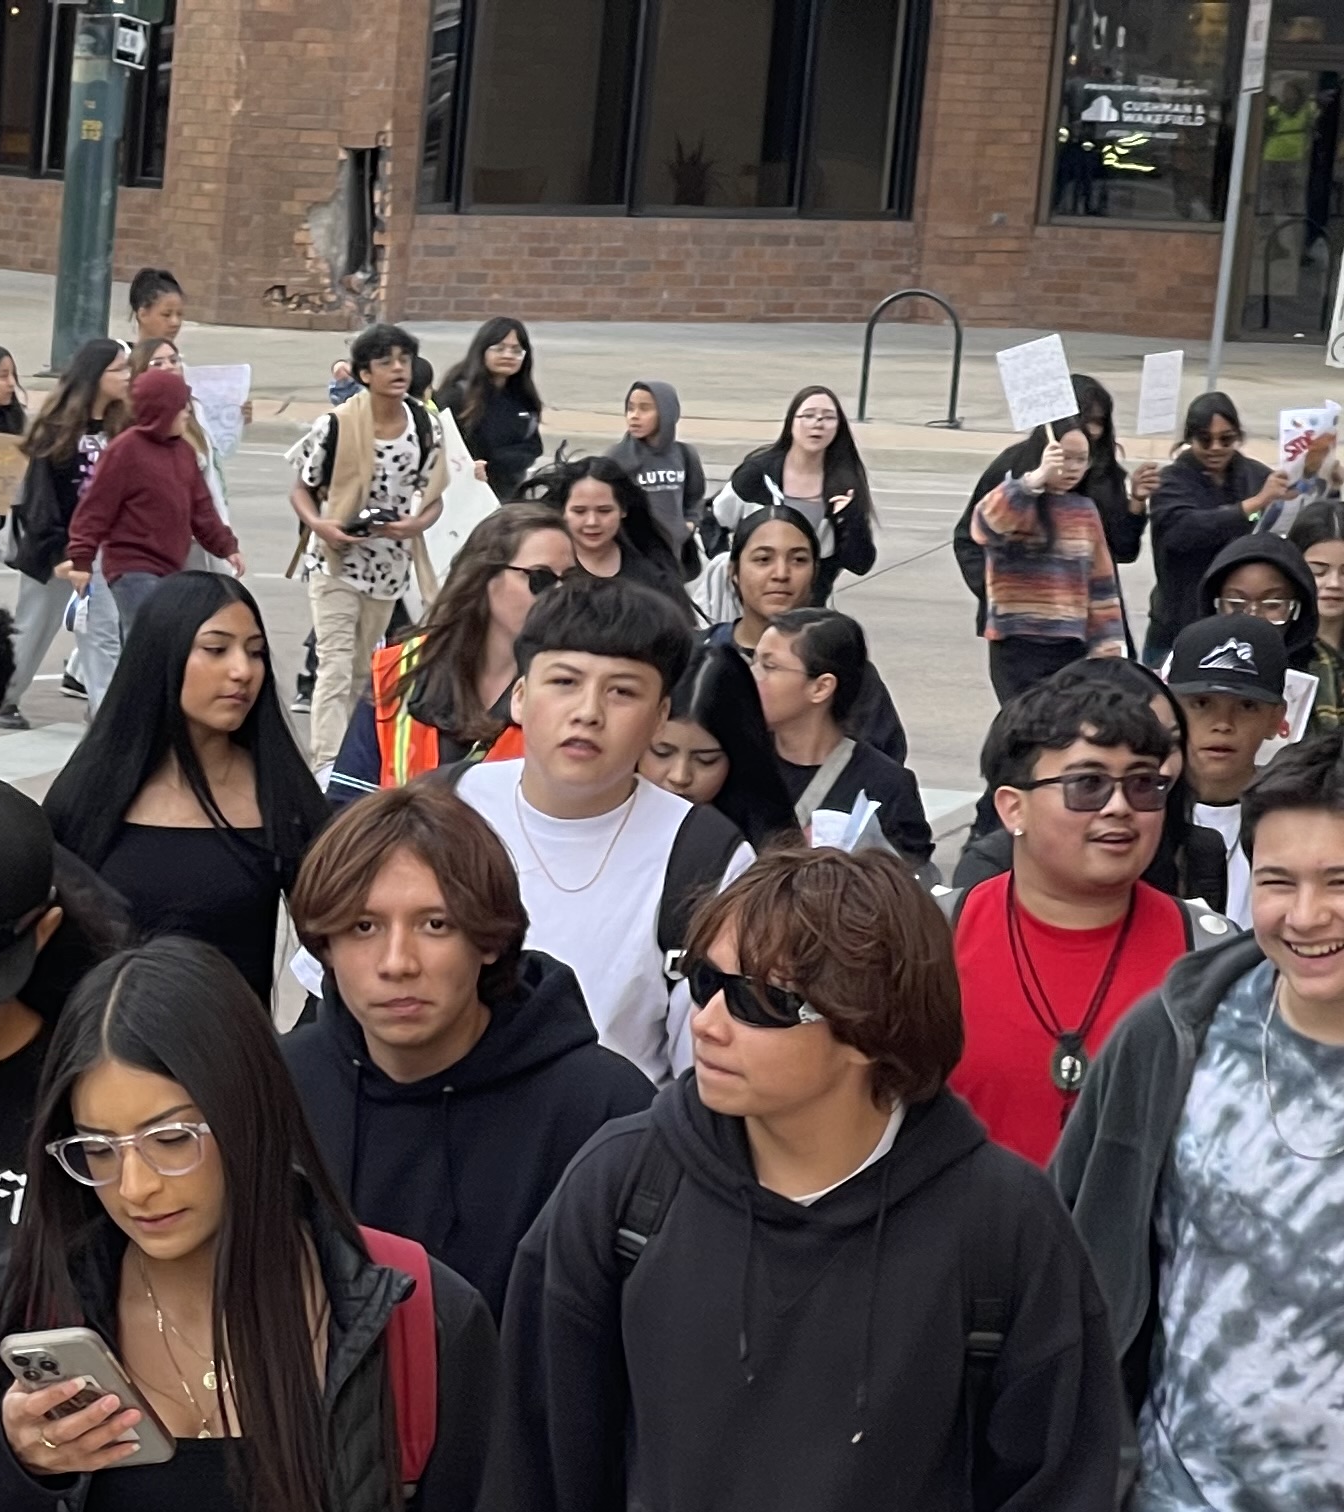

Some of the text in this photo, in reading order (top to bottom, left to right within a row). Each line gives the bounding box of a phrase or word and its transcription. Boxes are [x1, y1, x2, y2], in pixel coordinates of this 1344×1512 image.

[1122, 101, 1193, 114] CUSHMAN
[1122, 112, 1206, 127] WAKEFIELD
[638, 470, 686, 485] LUTCH
